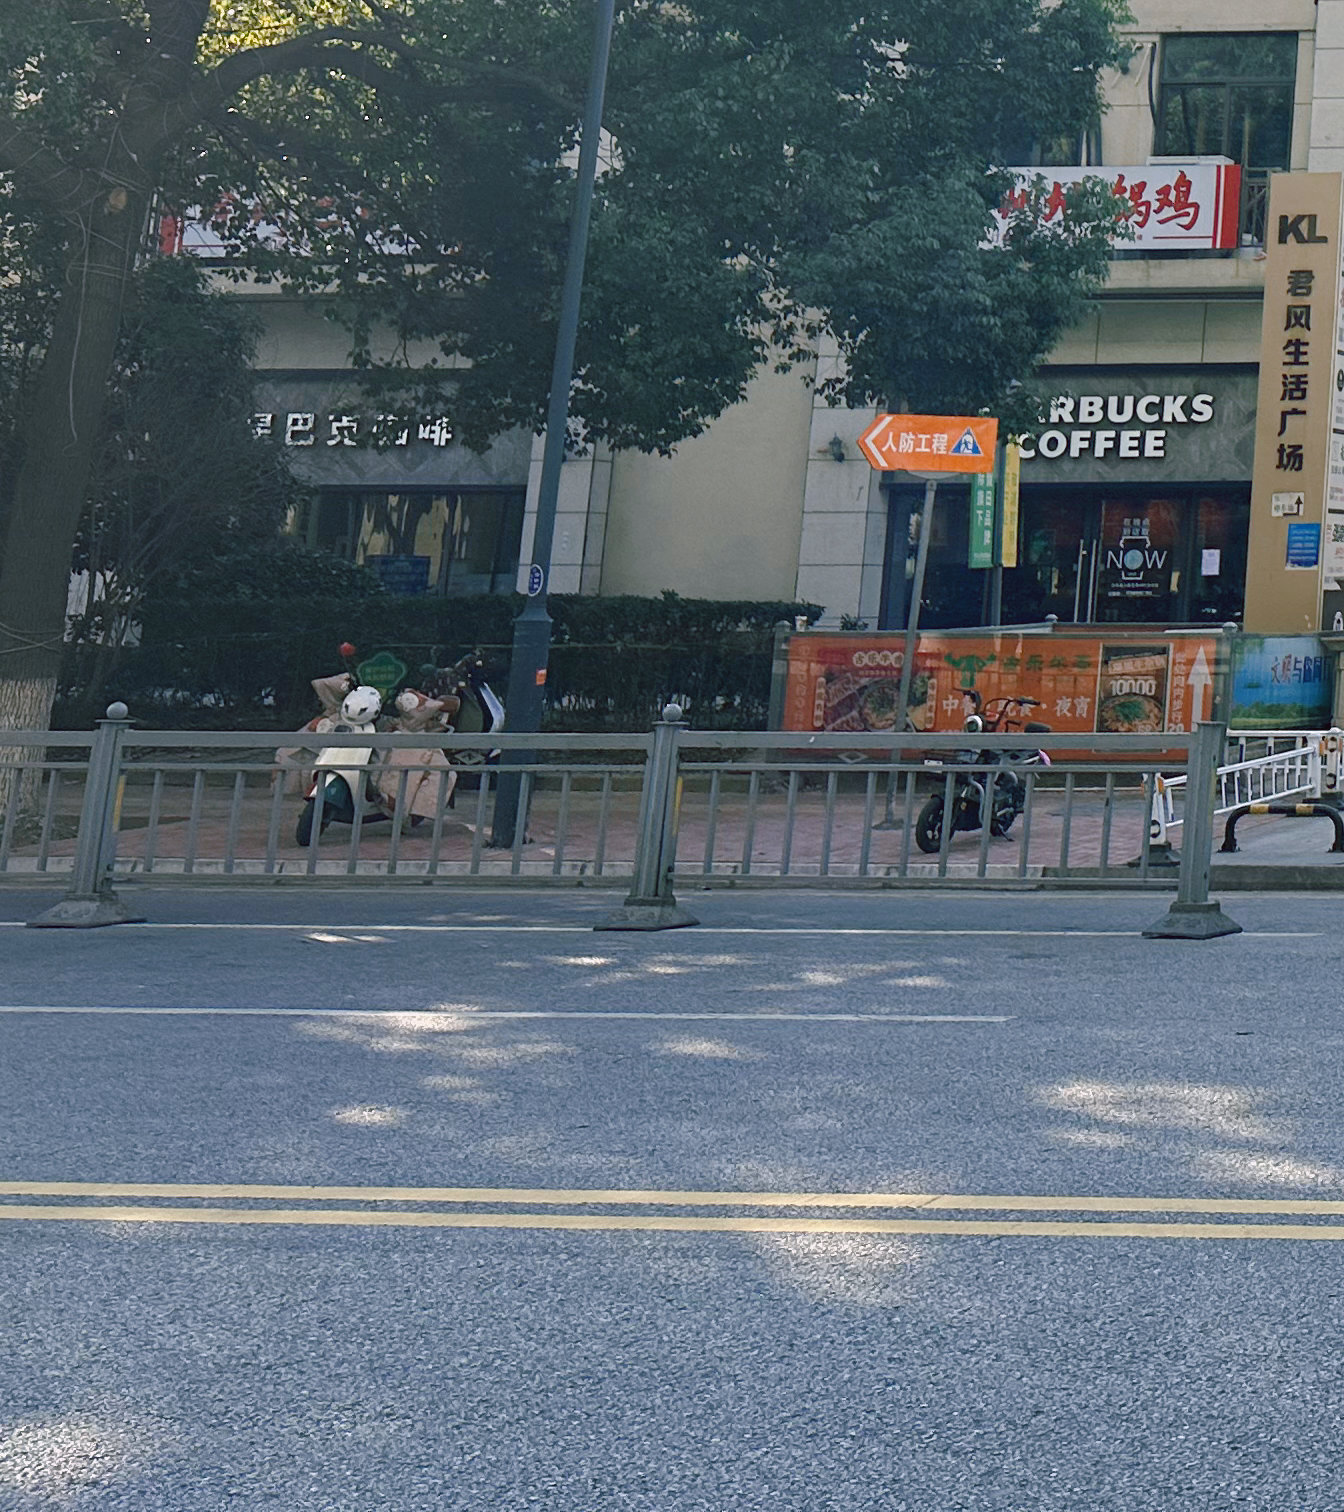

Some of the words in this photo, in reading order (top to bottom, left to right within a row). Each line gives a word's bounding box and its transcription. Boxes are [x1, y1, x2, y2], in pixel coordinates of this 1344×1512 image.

[1278, 214, 1328, 245] KL
[1276, 270, 1314, 472] 君风生活广场
[1038, 395, 1214, 424] RBUCKS
[882, 433, 950, 455] 人防工程
[1019, 430, 1166, 460] COFFEE
